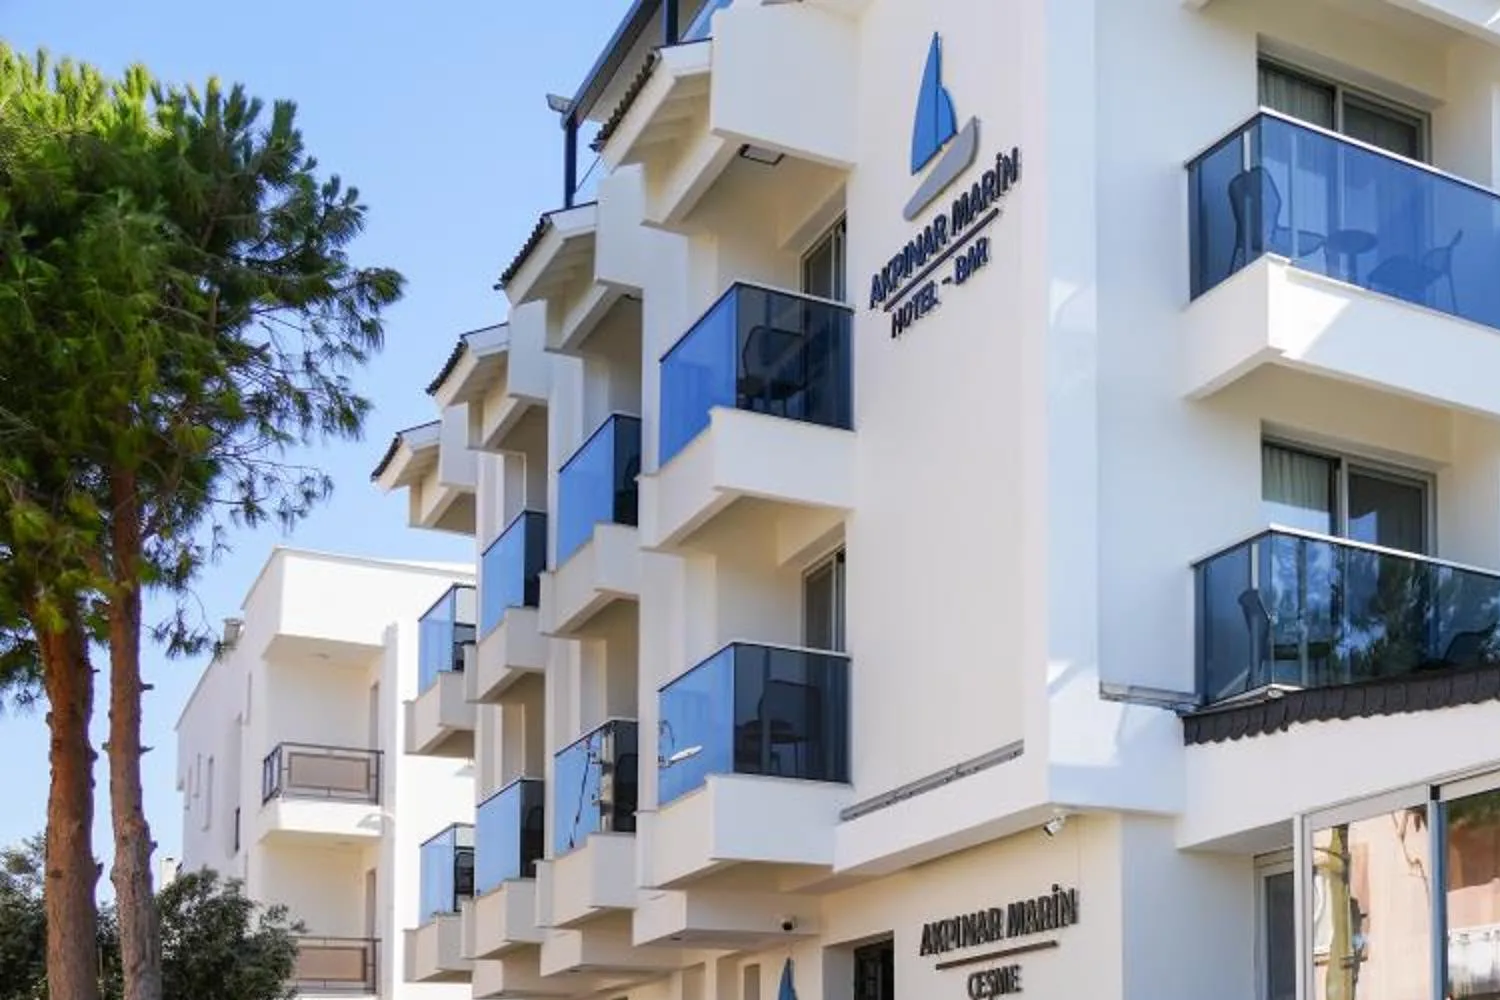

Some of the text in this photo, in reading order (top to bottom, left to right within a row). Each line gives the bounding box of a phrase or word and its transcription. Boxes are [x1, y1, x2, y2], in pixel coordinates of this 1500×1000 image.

[870, 147, 1020, 310] AKPINAR MARİN
[891, 280, 940, 338] HOTEL
[955, 237, 989, 285] BAR
[920, 884, 1080, 956] AKPINAR MARİN
